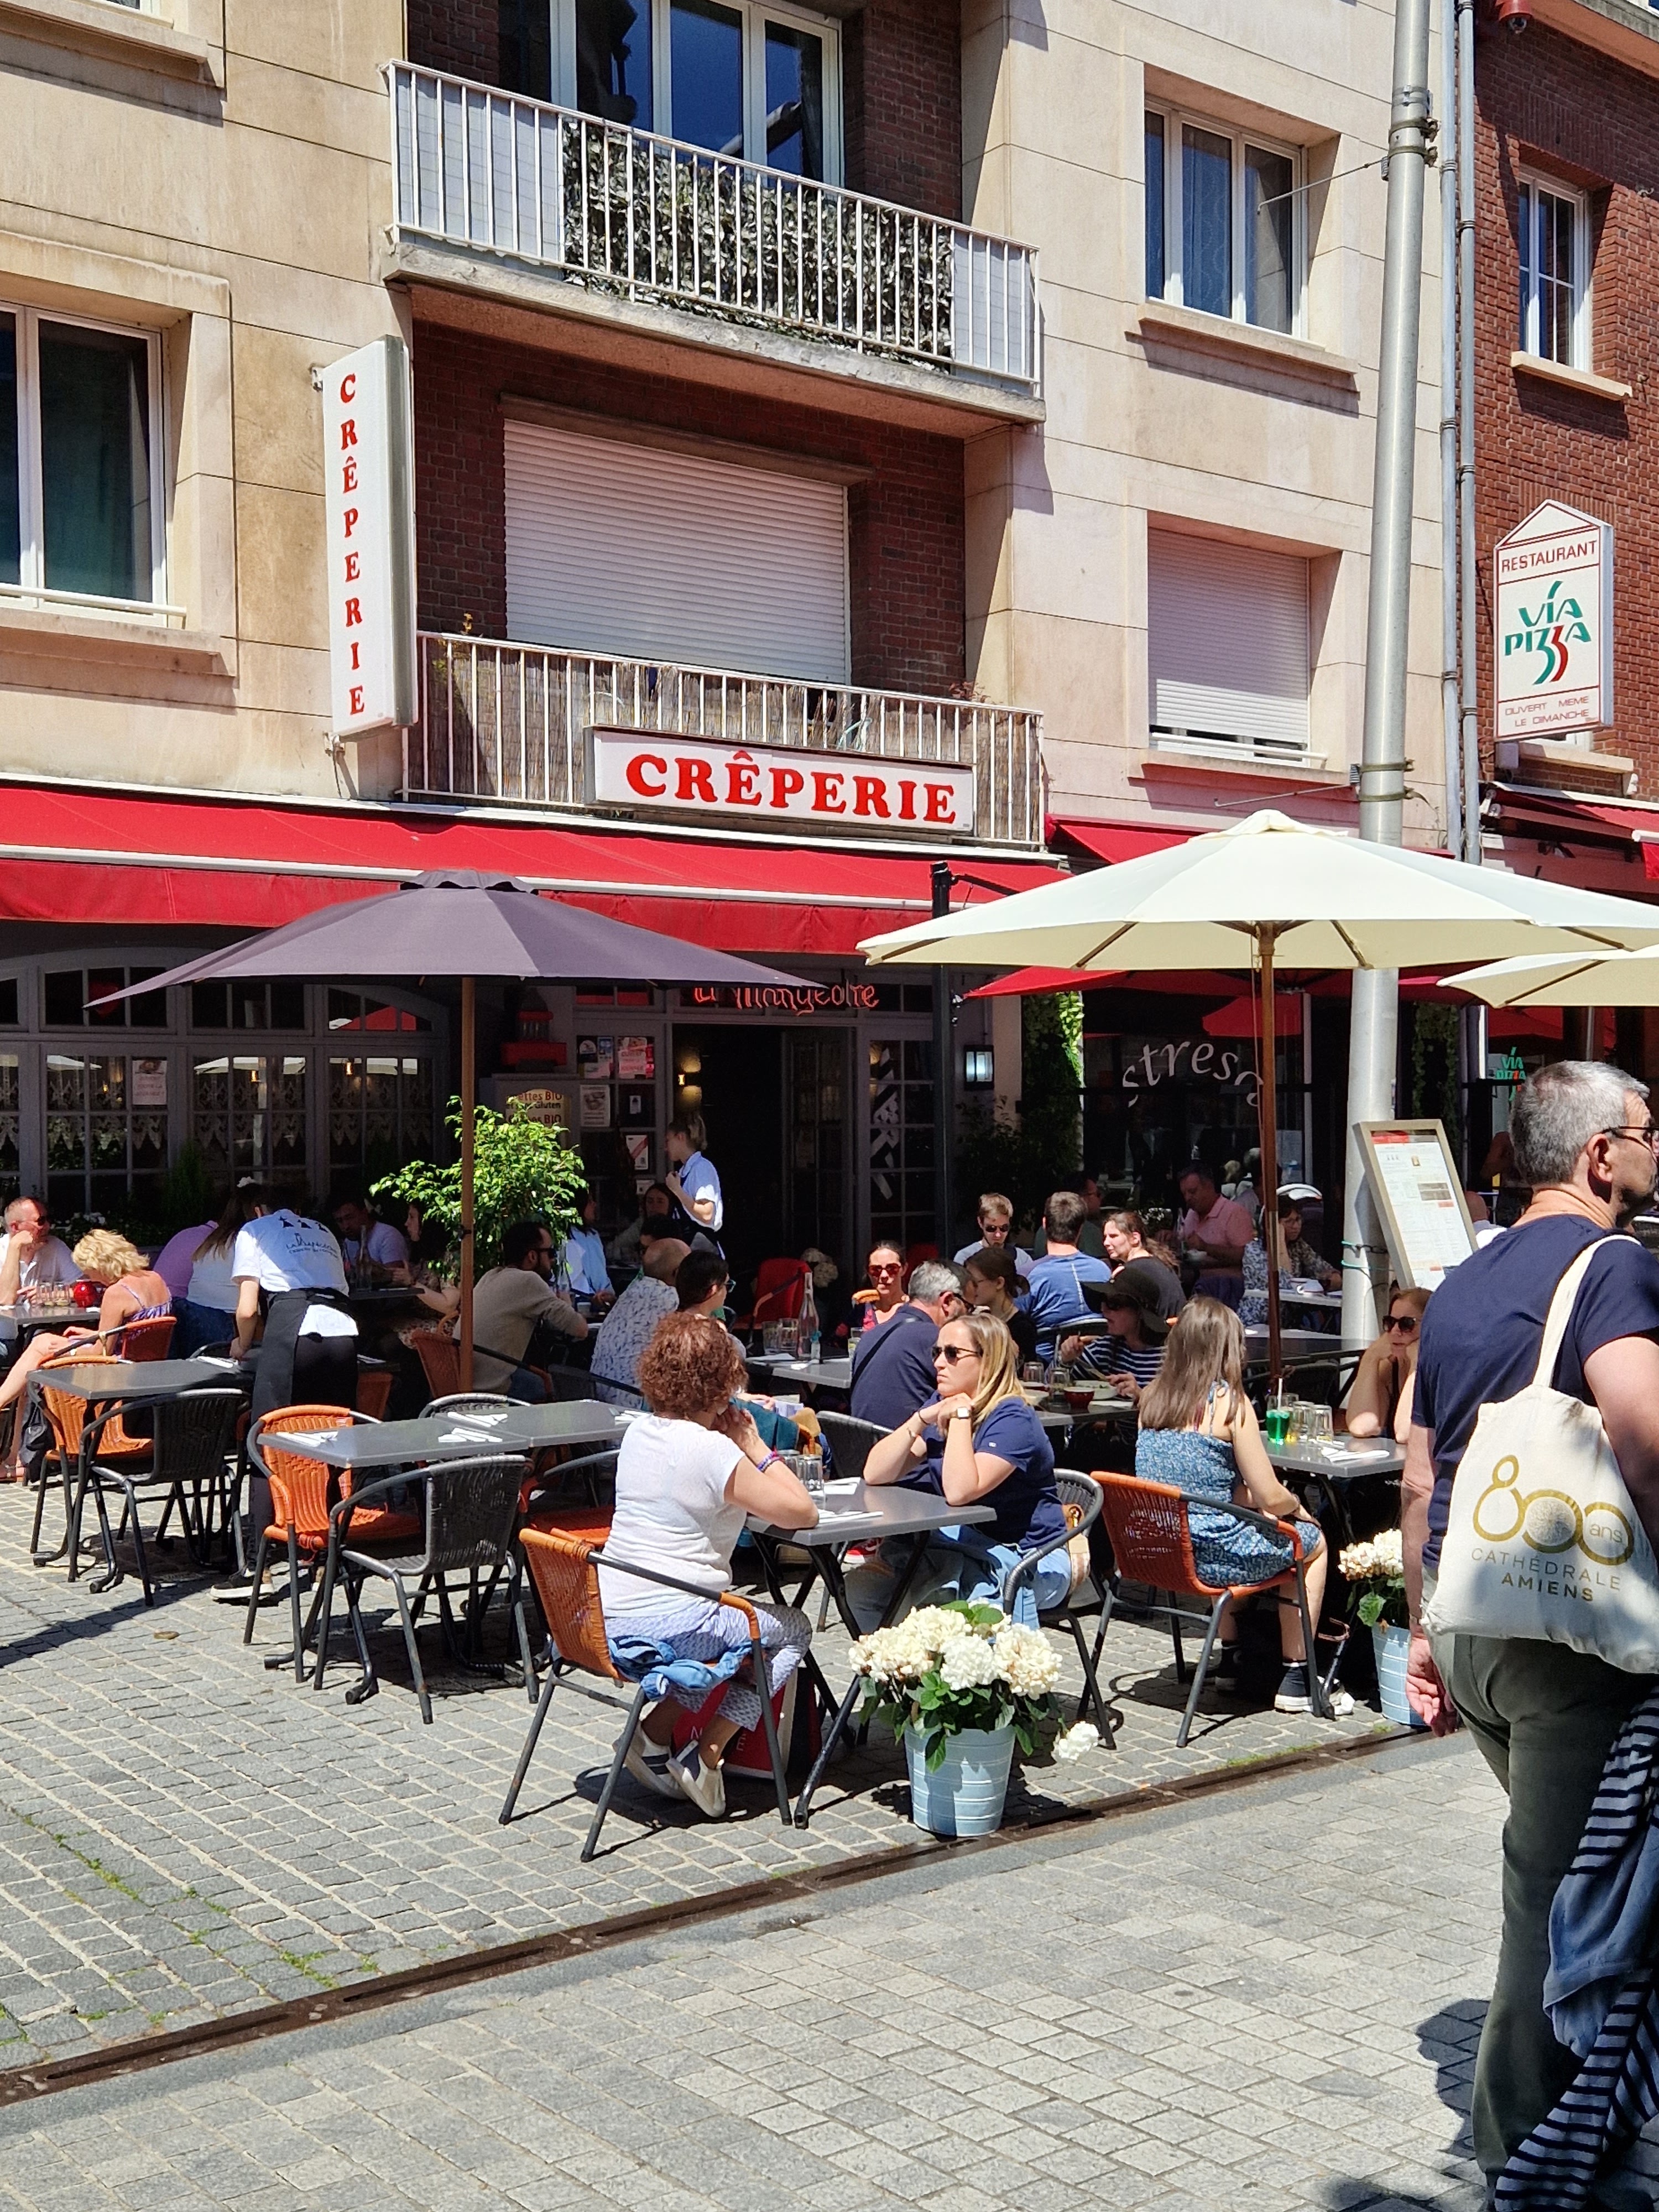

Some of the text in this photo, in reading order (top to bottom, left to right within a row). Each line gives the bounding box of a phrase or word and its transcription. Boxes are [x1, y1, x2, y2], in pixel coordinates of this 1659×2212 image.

[340, 373, 365, 715] CRÊPERIE
[1501, 540, 1597, 573] RESTAURANT
[1504, 622, 1592, 685] PIZZA
[1505, 696, 1589, 716] OUVERT MEME
[1515, 709, 1589, 727] LE DIMANCHE
[625, 750, 957, 824] CRÊPERIE
[1473, 1454, 1634, 1566] 800
[1589, 1522, 1623, 1544] ans
[1471, 1547, 1621, 1590] CATHÉDRALE
[1501, 1572, 1594, 1601] AMIENS
